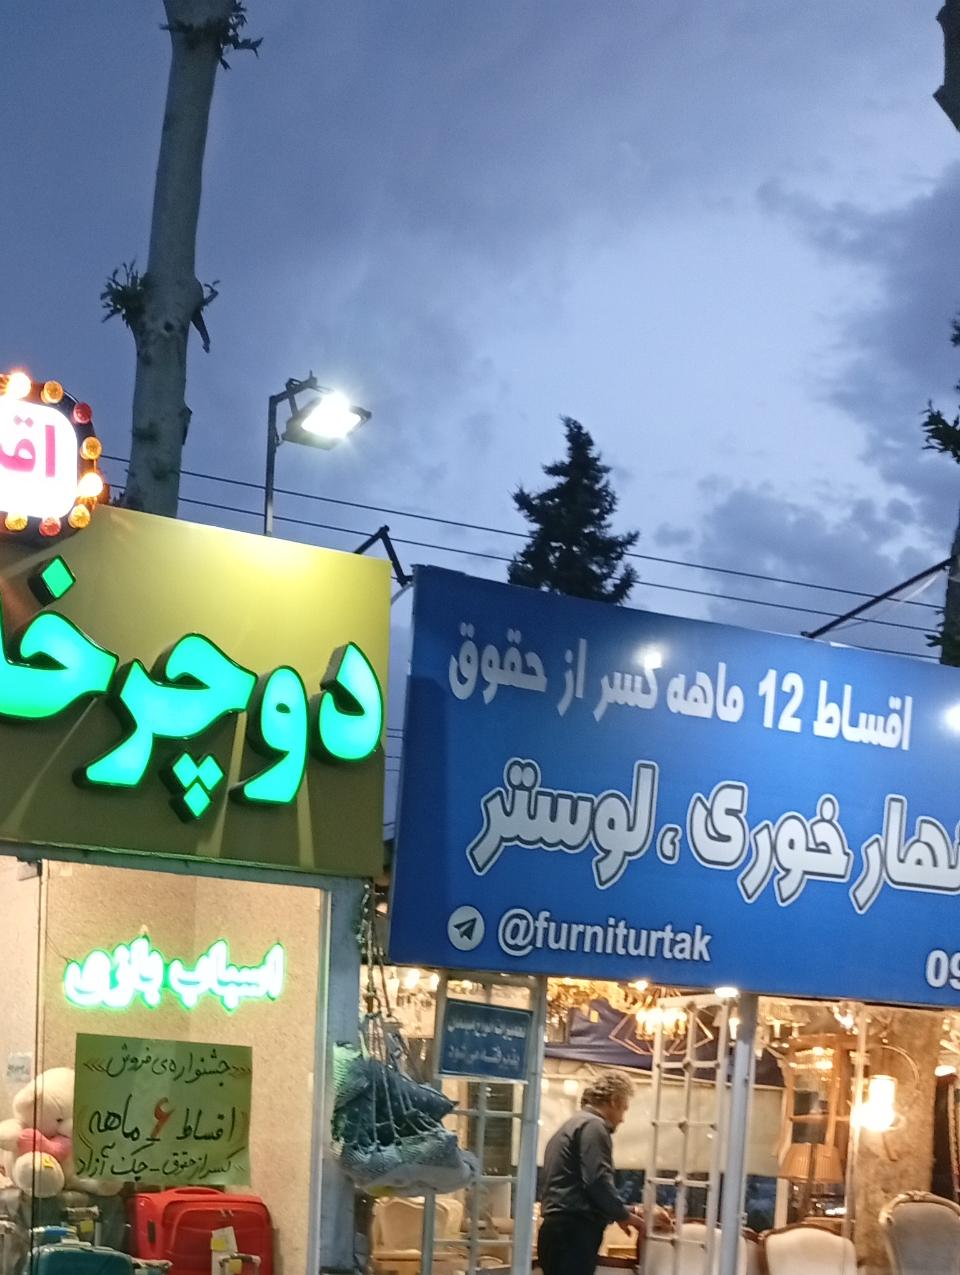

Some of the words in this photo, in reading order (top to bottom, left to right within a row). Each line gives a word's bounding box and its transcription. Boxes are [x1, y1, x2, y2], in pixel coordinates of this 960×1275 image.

[448, 621, 548, 705] حقوق
[556, 637, 588, 718] از
[592, 648, 663, 722] کسر
[666, 661, 745, 724] ماهه
[757, 668, 805, 733] 12
[813, 679, 913, 751] اقساط
[466, 757, 659, 890] لوستر
[848, 793, 960, 915] هار
[63, 933, 165, 1010] بازی
[498, 908, 713, 963] @furniturtak
[168, 937, 285, 1012] اسباب
[88, 1093, 141, 1142] ماهه
[175, 1106, 237, 1142] اقساط
